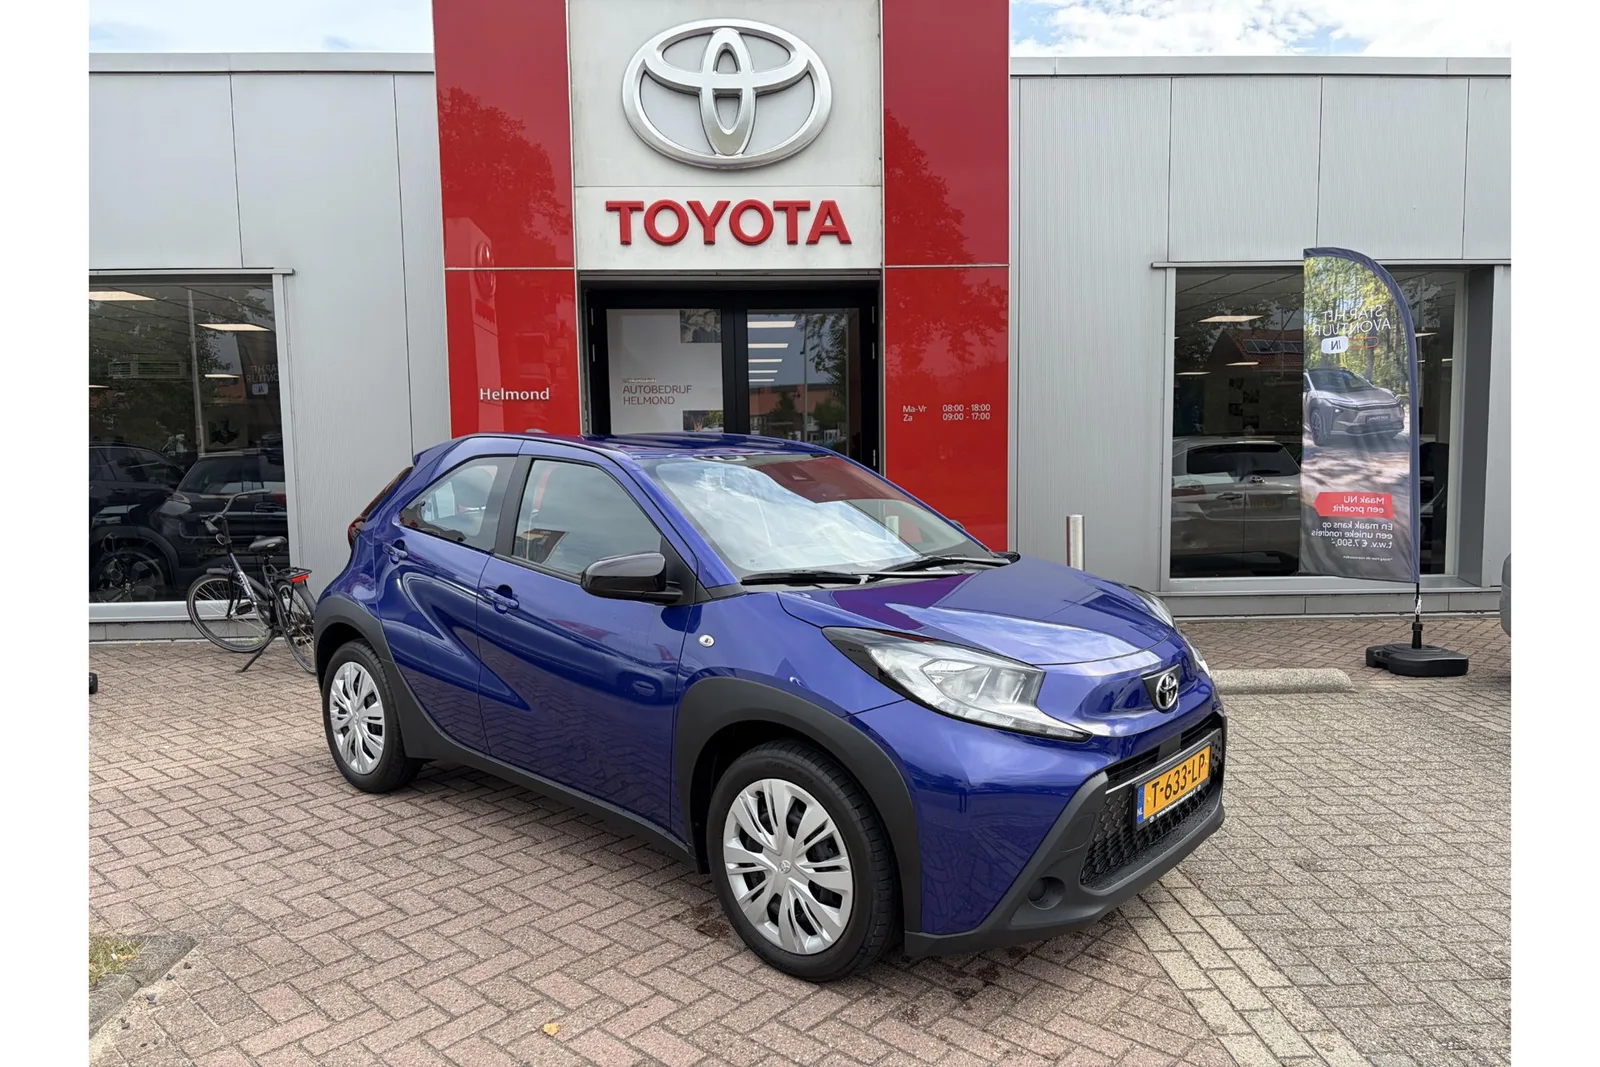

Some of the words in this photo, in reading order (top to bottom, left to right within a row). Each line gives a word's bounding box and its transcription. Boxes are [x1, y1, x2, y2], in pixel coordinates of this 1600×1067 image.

[605, 199, 852, 246] TOYOTA
[479, 387, 550, 401] Helmond
[622, 384, 692, 394] AUTOBEDRIJF
[623, 396, 675, 405] HELMOND
[902, 405, 927, 413] Ma-Vr
[942, 404, 964, 412] 08:00
[971, 403, 991, 411] 18:00
[903, 414, 913, 422] Za
[942, 412, 964, 421] 09:00
[971, 412, 991, 420] 17:00
[1151, 753, 1206, 808] T-633-LP
